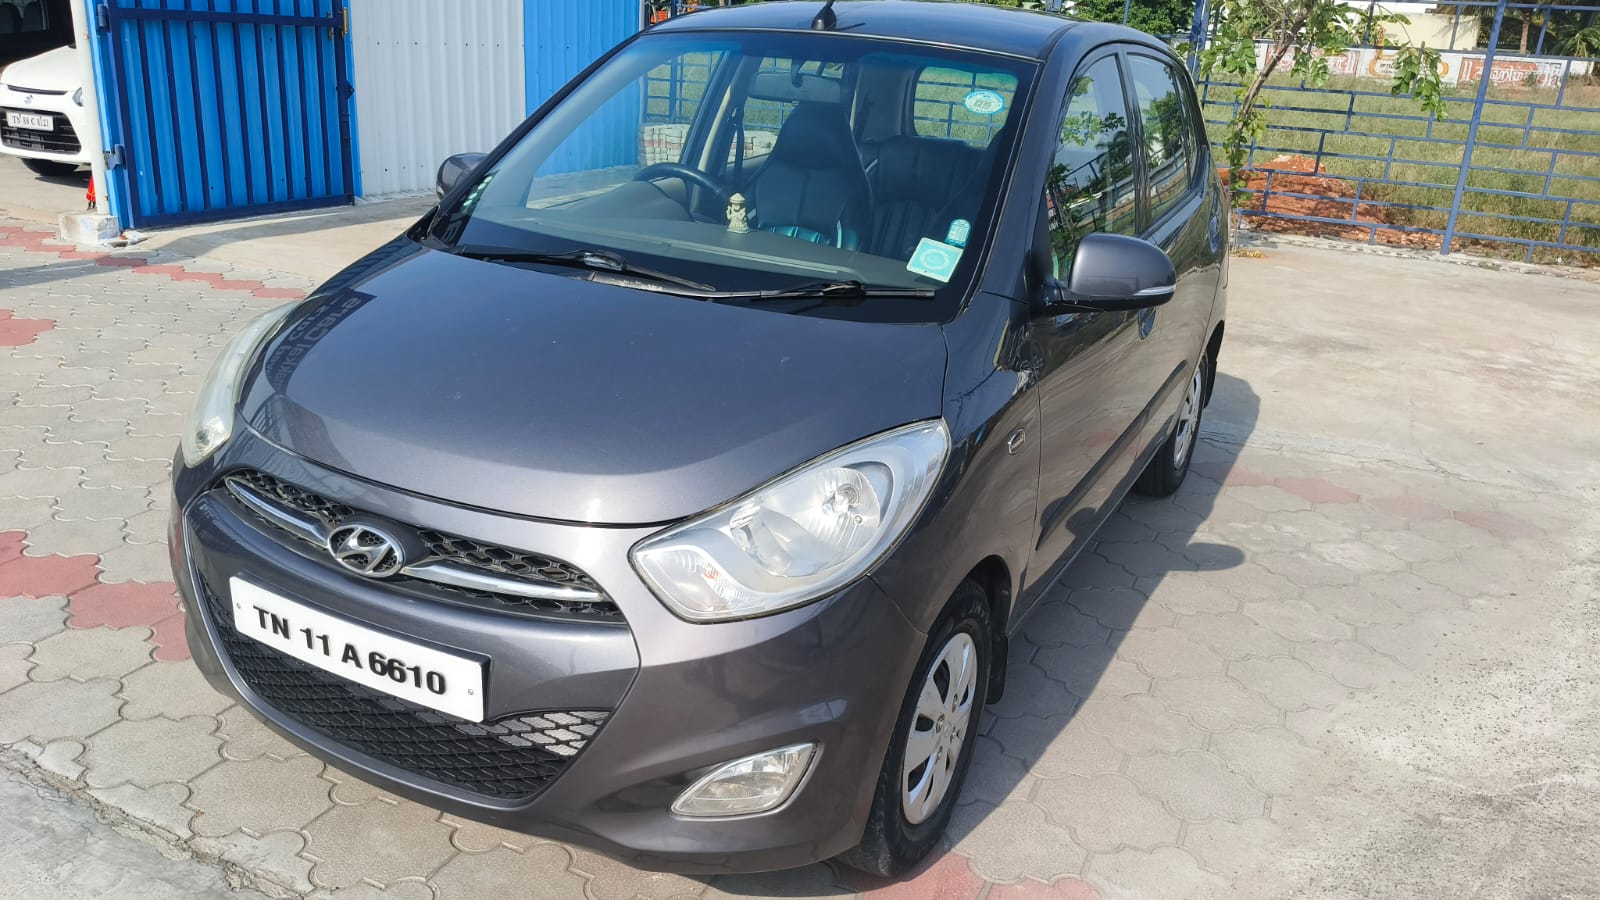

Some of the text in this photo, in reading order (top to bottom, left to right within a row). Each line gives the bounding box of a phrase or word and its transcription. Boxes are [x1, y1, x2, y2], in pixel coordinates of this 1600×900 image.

[252, 604, 446, 695] TN 11 A 6610
